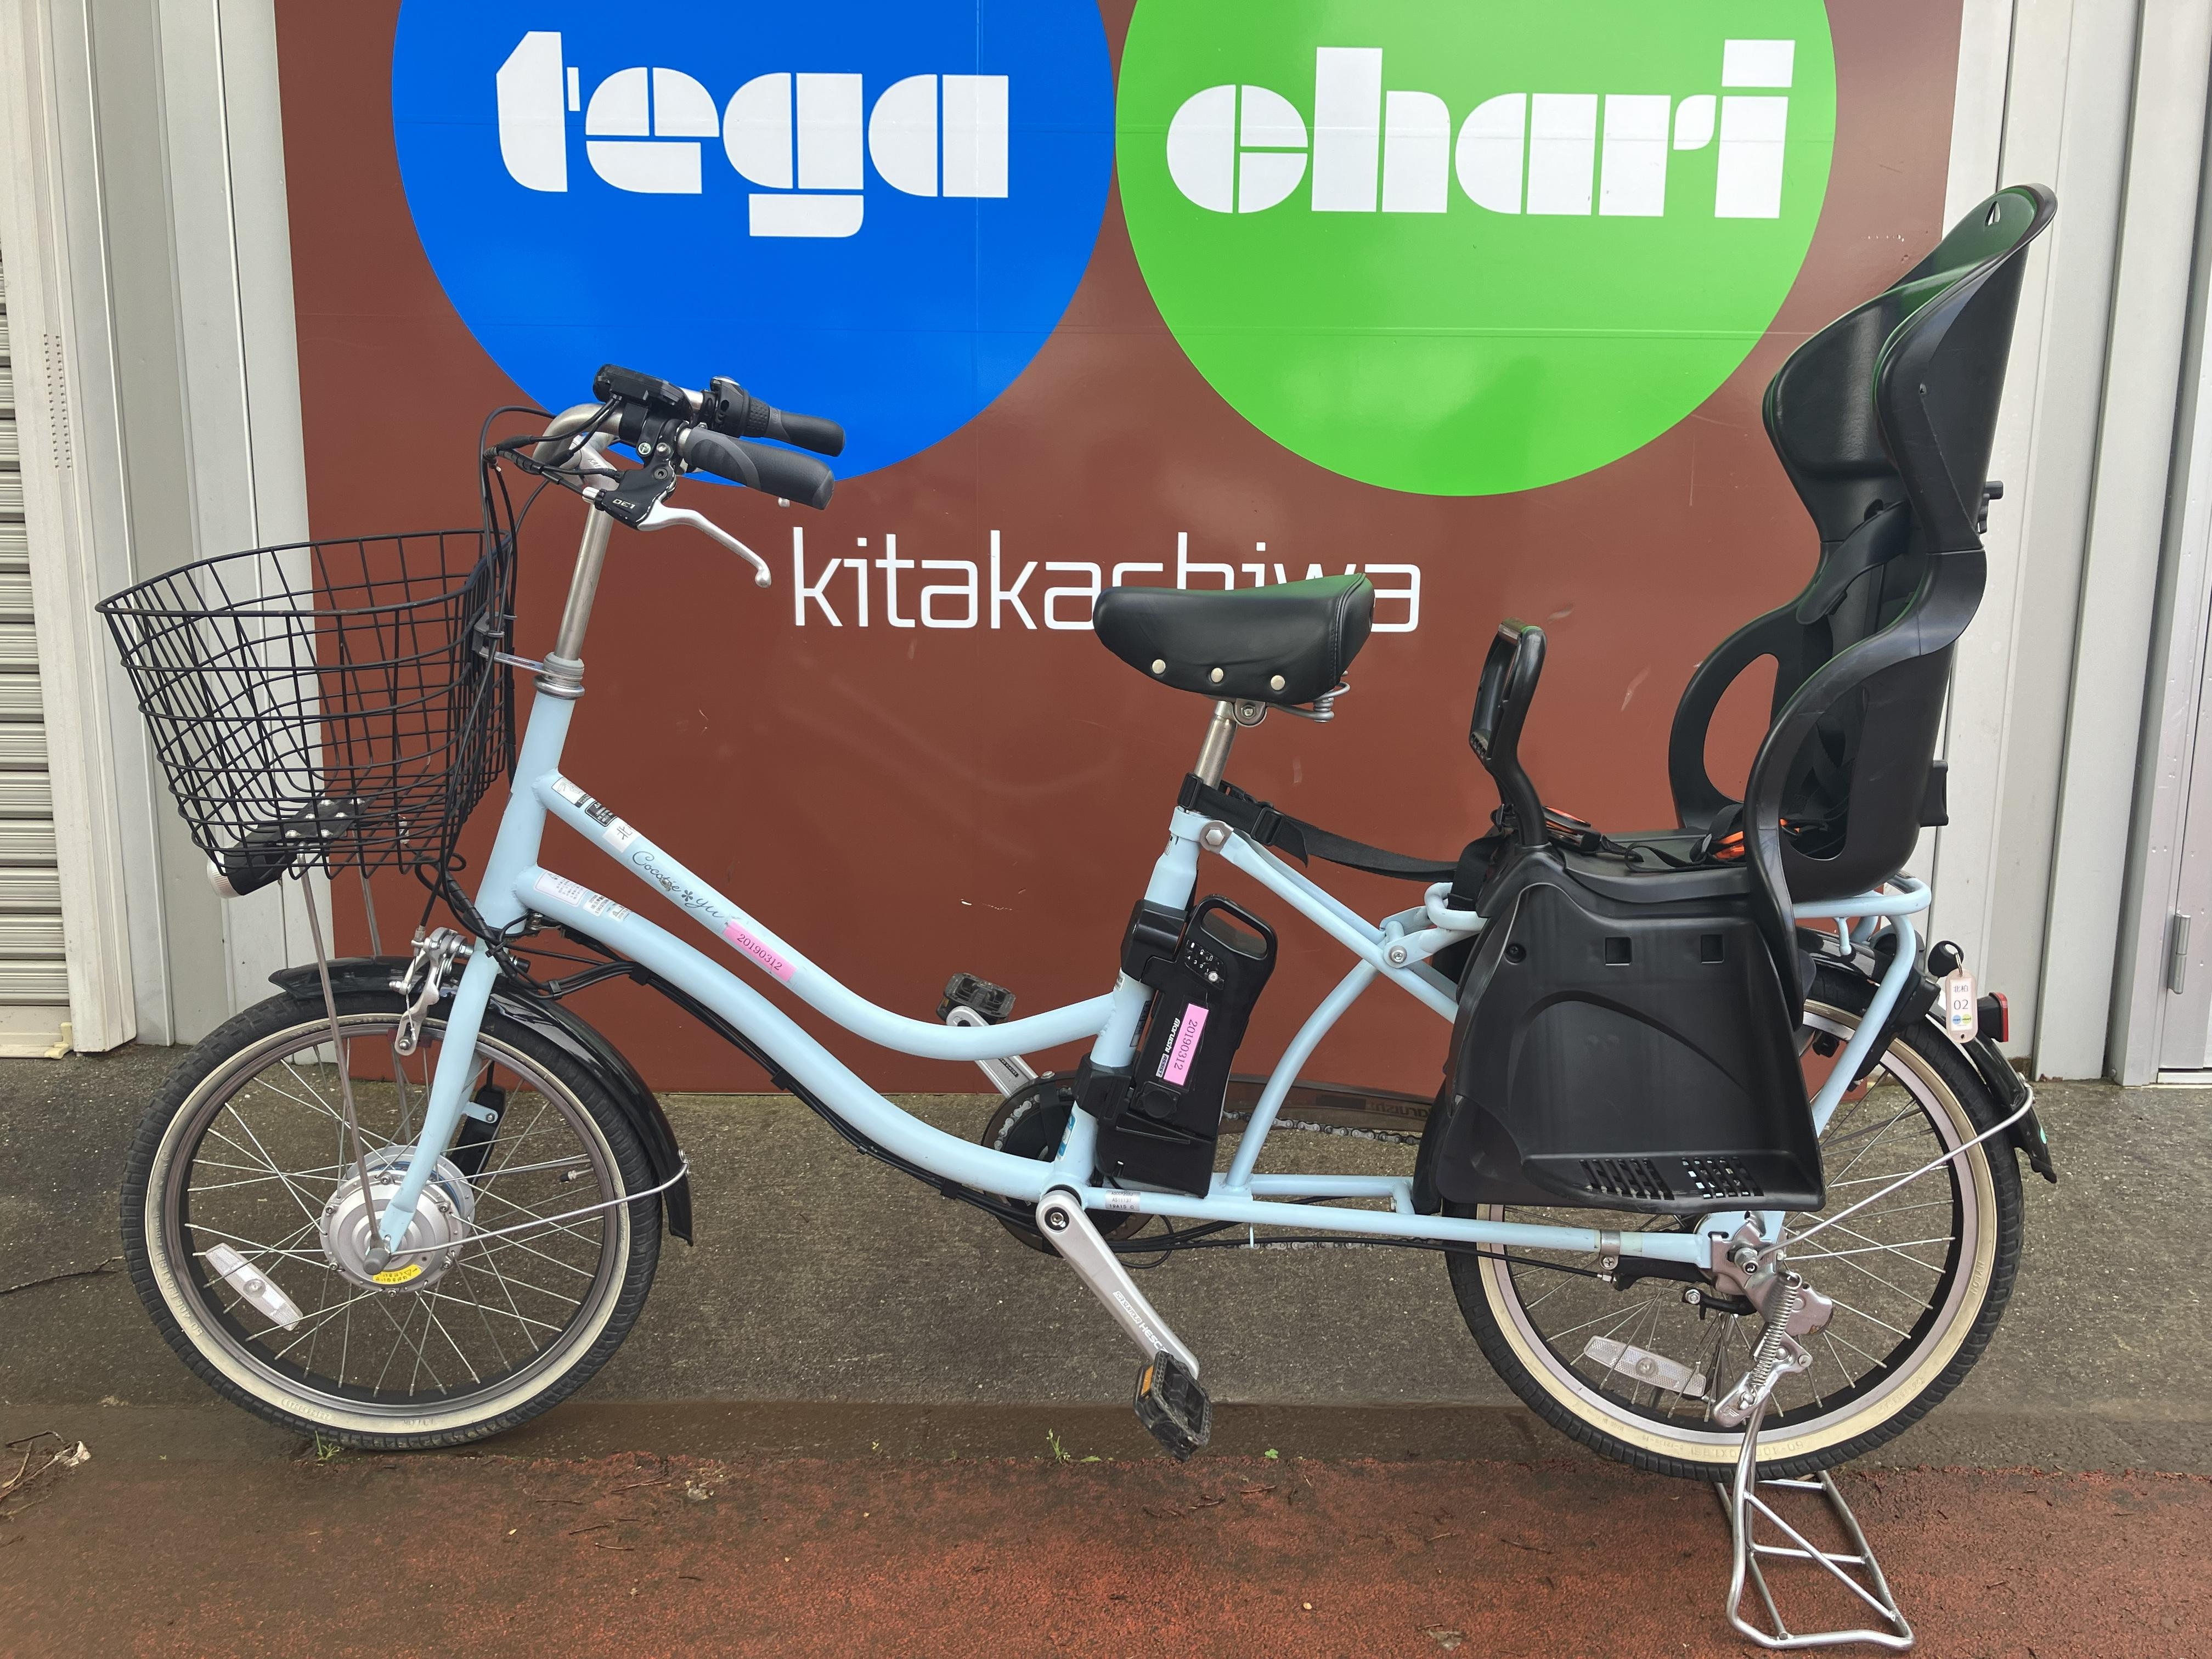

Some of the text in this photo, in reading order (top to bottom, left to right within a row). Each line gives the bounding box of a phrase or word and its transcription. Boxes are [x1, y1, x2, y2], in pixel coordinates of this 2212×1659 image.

[496, 31, 1008, 238] tega
[617, 823, 635, 840] 北
[737, 934, 782, 970] 20190312
[1954, 985, 1968, 993] 北柏
[1954, 999, 1968, 1010] 02
[1174, 1019, 1198, 1070] 20190312
[1158, 1055, 1167, 1076] ASSIST
[1123, 1300, 1142, 1323] SUNTOUR
